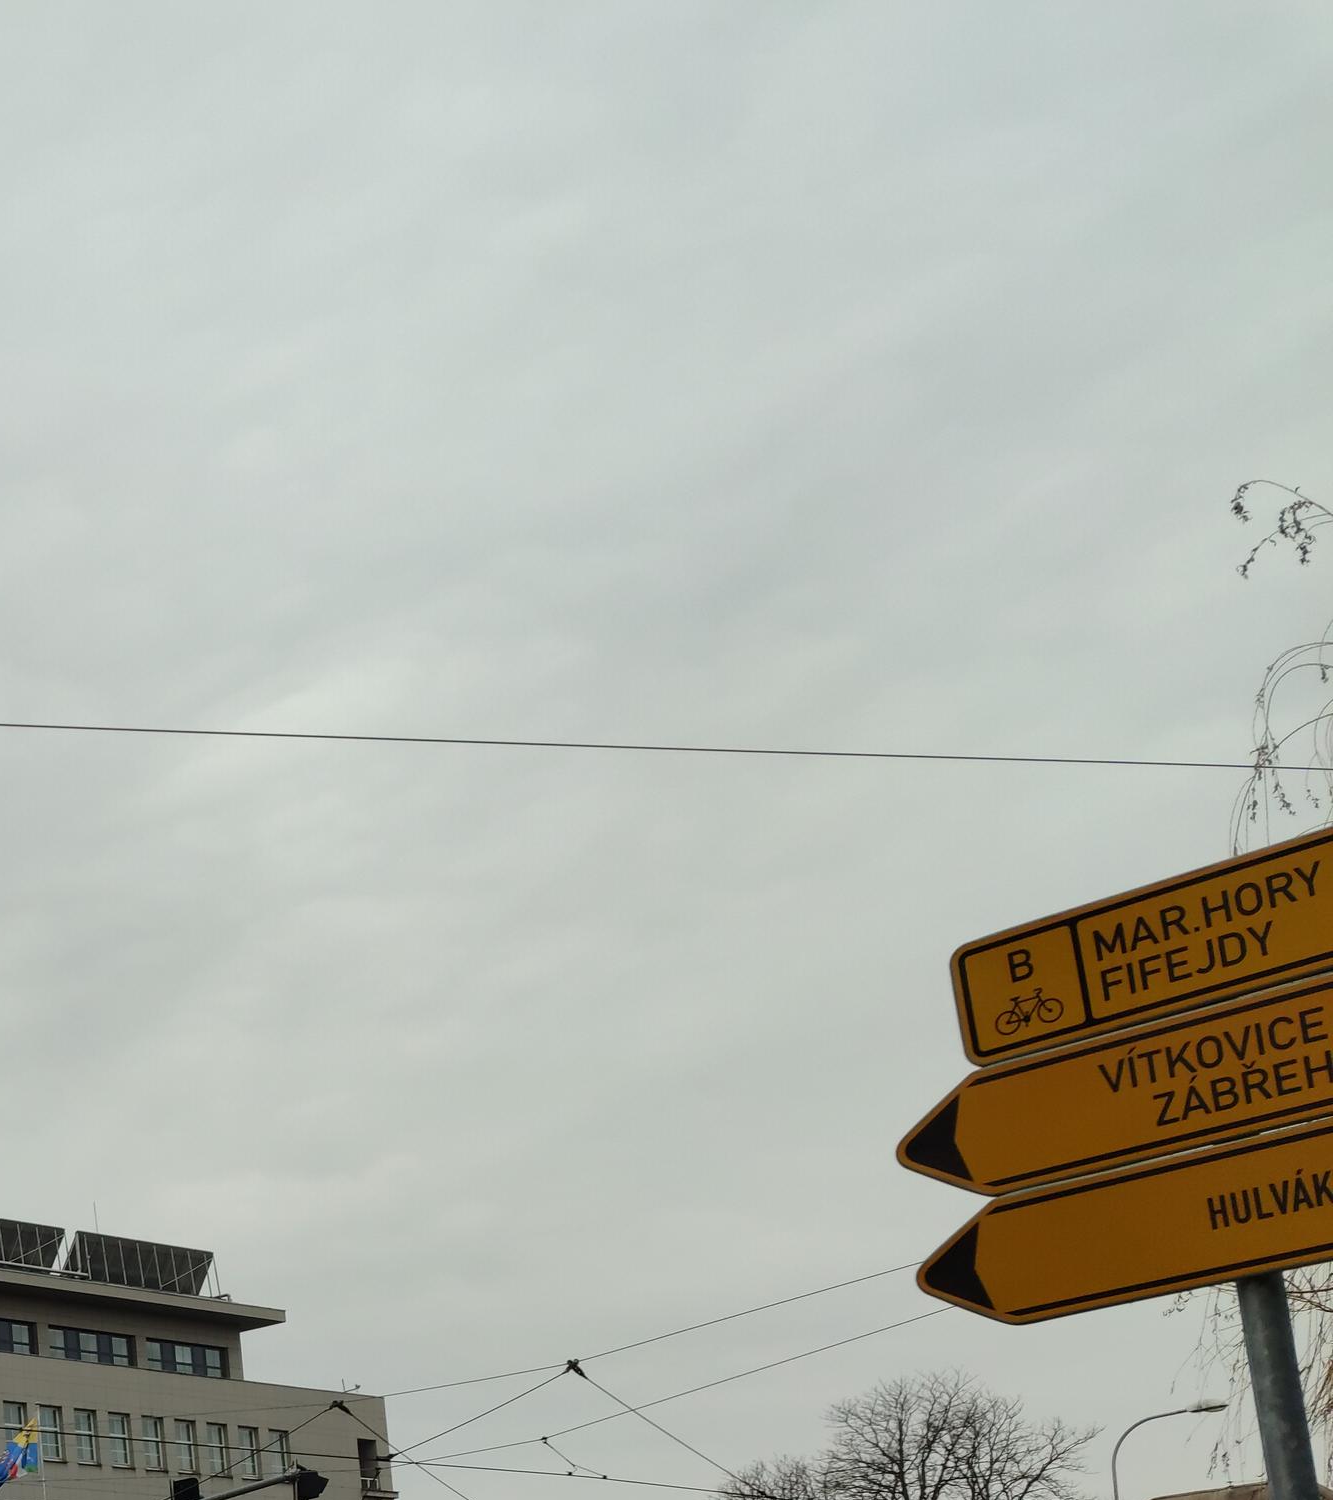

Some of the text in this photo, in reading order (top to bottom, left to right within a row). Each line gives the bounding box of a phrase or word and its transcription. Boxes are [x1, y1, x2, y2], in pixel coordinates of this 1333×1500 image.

[1092, 860, 1322, 962] MAR.HORY
[1006, 948, 1035, 984] B
[1100, 920, 1274, 1002] FIFEJDY
[1097, 1006, 1329, 1093] VÍTKOVICE
[1152, 1050, 1333, 1127] ZÁBŘEH
[1206, 1168, 1333, 1231] HULVÁK
